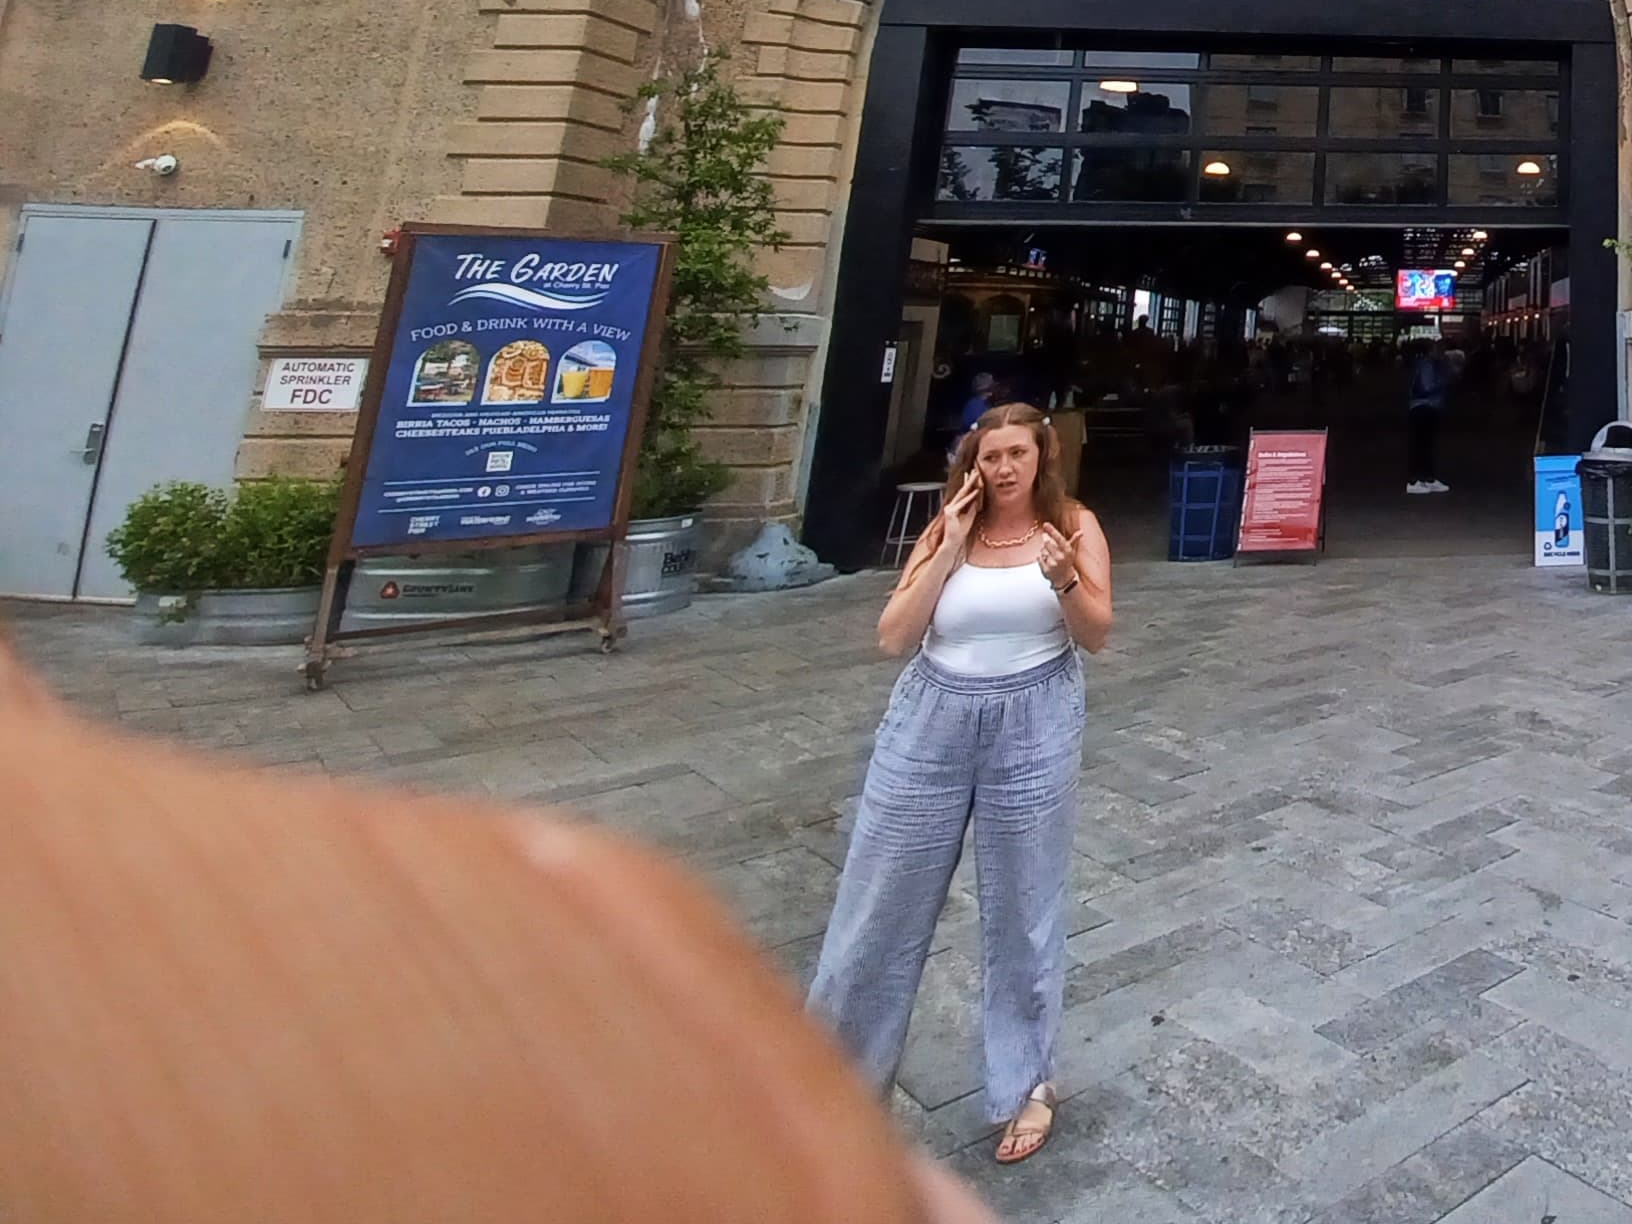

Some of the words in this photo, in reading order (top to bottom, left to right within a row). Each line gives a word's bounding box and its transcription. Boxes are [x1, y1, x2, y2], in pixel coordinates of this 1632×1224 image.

[454, 253, 507, 281] THE
[510, 254, 619, 283] GARDEN
[410, 323, 458, 342] FOOD
[461, 320, 473, 333] &
[477, 318, 529, 331] DRINK
[532, 318, 575, 332] WITH
[577, 321, 588, 334] A
[593, 324, 631, 342] VIEW
[282, 362, 355, 373] AUTOMATIC
[280, 375, 352, 385] SPRINKLER
[290, 388, 333, 404] FDC
[436, 418, 471, 428] TACOS
[478, 417, 522, 426] NACHOS
